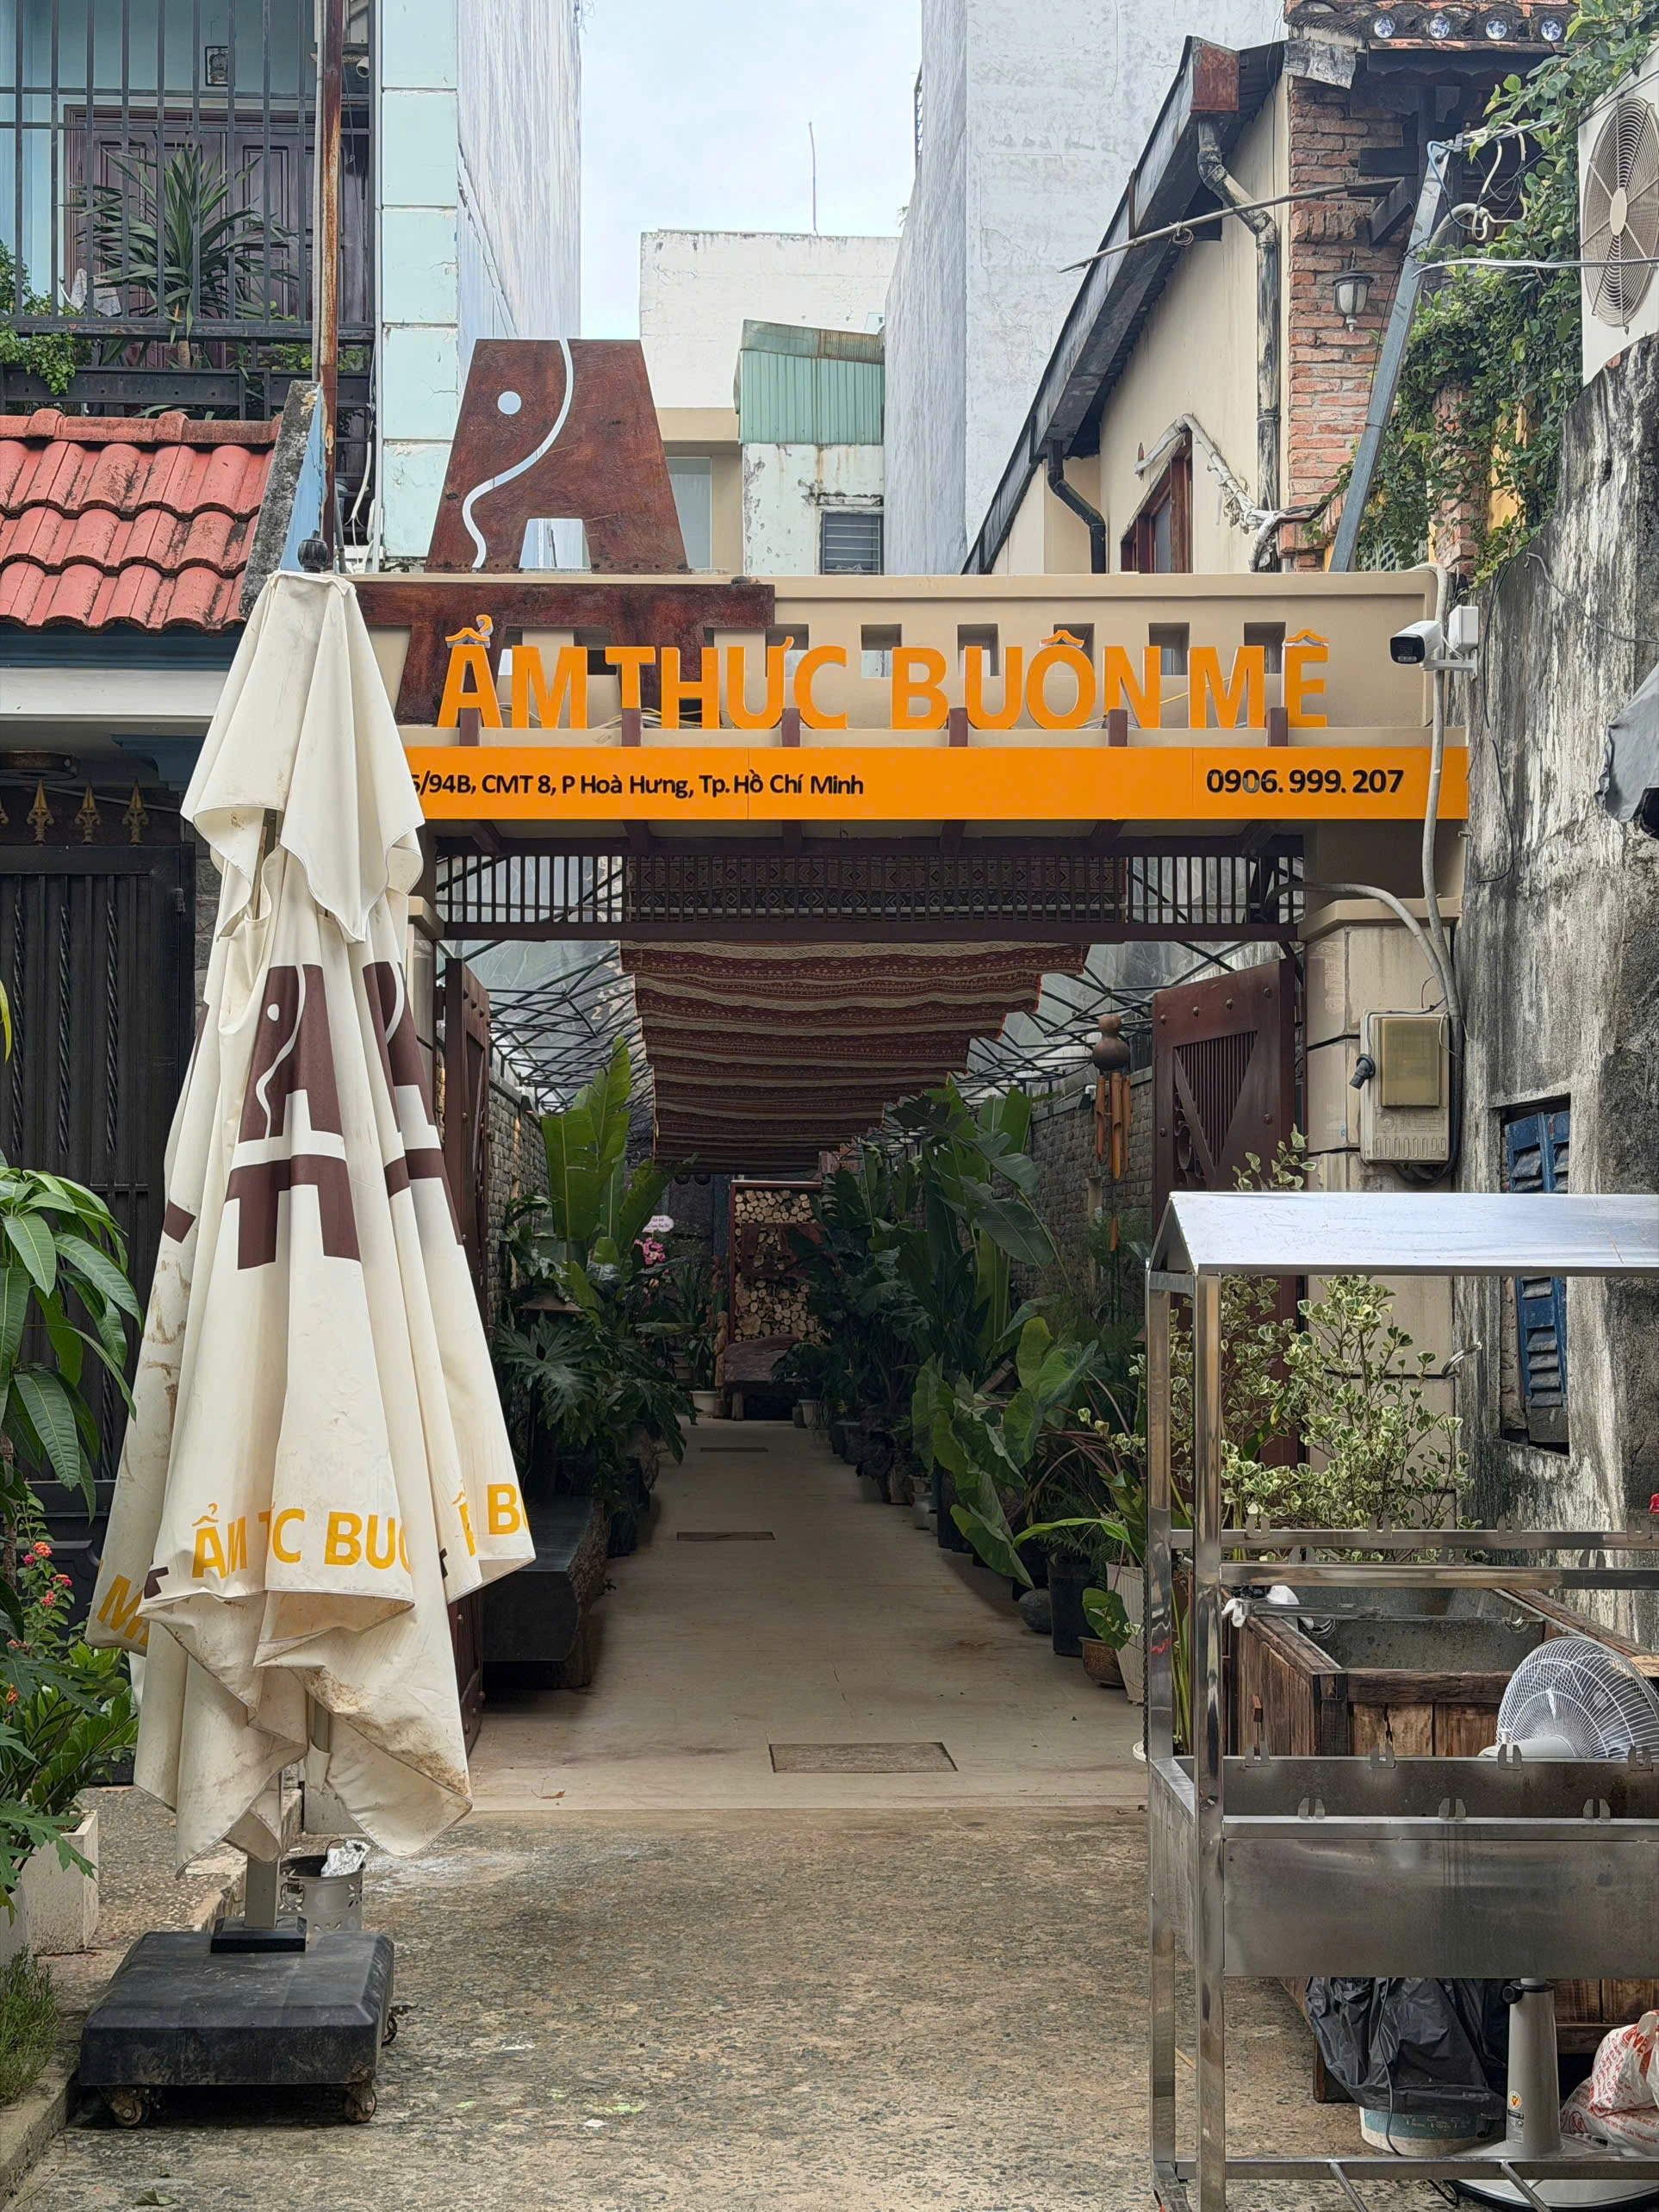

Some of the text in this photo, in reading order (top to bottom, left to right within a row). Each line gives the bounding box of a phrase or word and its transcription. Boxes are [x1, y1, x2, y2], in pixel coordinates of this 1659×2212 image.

[437, 614, 587, 730] ẨM
[890, 629, 1162, 730] BUÔN
[1189, 628, 1329, 730] MÊ
[481, 774, 533, 794] CMT
[537, 774, 557, 796] 8,
[562, 774, 575, 794] P
[580, 774, 623, 794] Hoà
[629, 774, 694, 799] Hưng,
[768, 774, 804, 794] Chí
[810, 774, 864, 794] Minh
